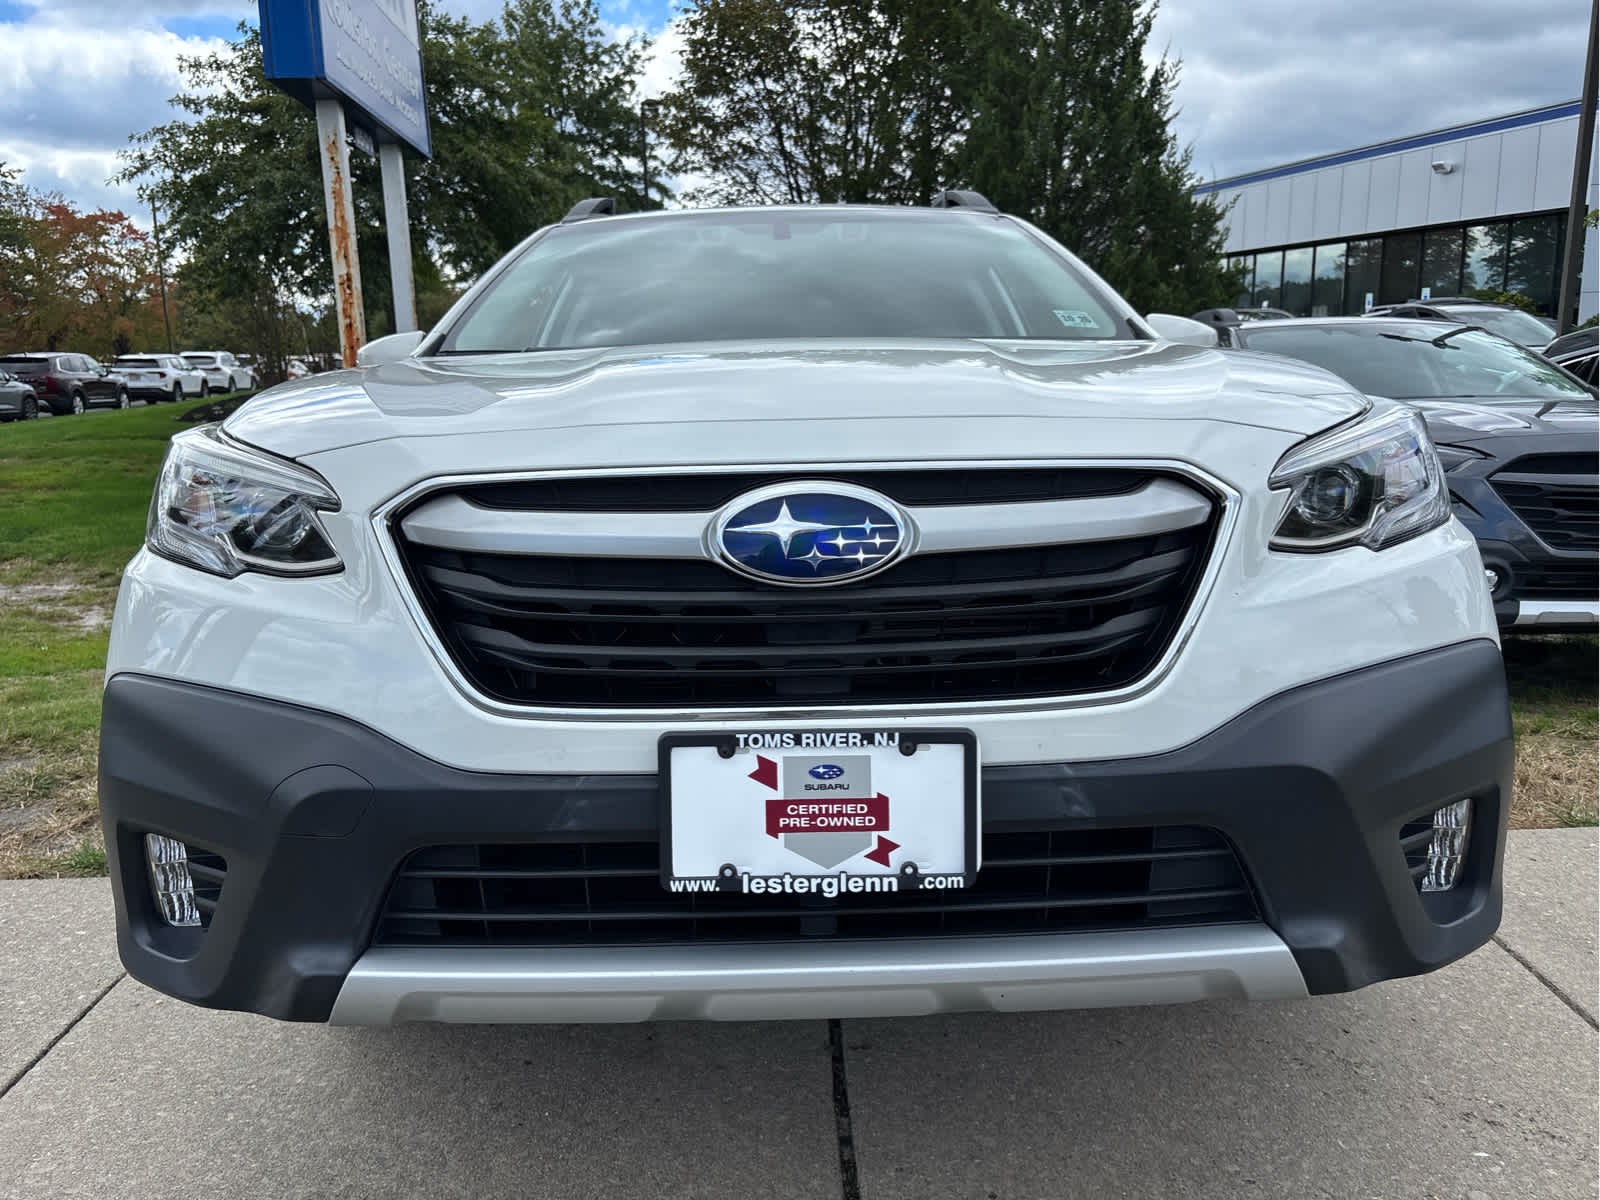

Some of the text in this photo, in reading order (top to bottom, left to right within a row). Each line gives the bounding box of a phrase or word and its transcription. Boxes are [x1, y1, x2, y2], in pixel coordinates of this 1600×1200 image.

[735, 732, 900, 749] TOMS RIVER, NJ
[804, 783, 850, 791] SUBARU
[786, 803, 868, 815] CERTIFIED
[779, 816, 876, 828] PRE-OWNED
[669, 873, 965, 898] www. lesterglenn .com
